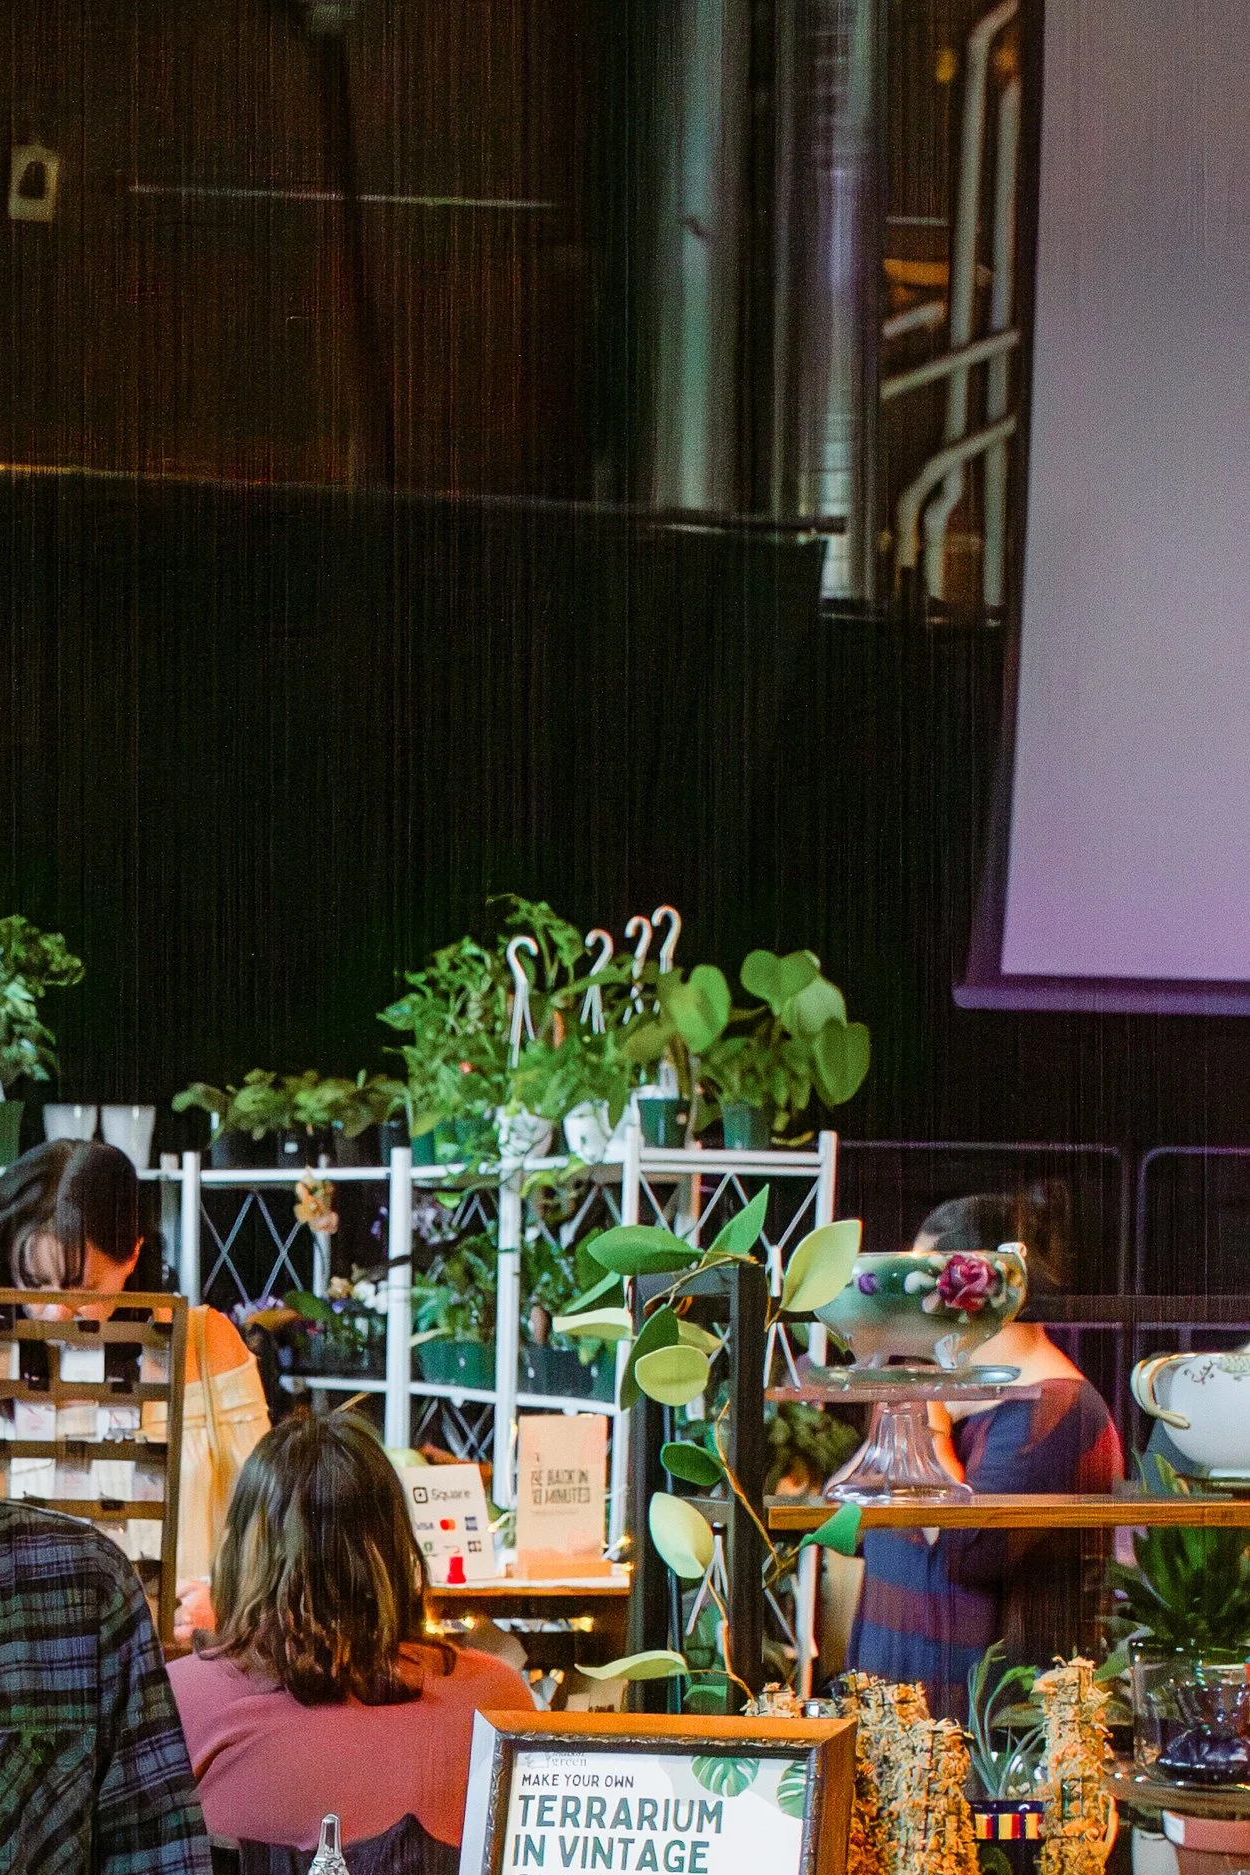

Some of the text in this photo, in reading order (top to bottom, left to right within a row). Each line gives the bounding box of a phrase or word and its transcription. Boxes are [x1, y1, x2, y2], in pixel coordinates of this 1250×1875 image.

[432, 1488, 471, 1501] Square
[521, 1773, 634, 1788] MAKE YOUR OWN
[518, 1794, 724, 1834] TERRARIUM
[512, 1834, 710, 1875] IN VINTAGE
